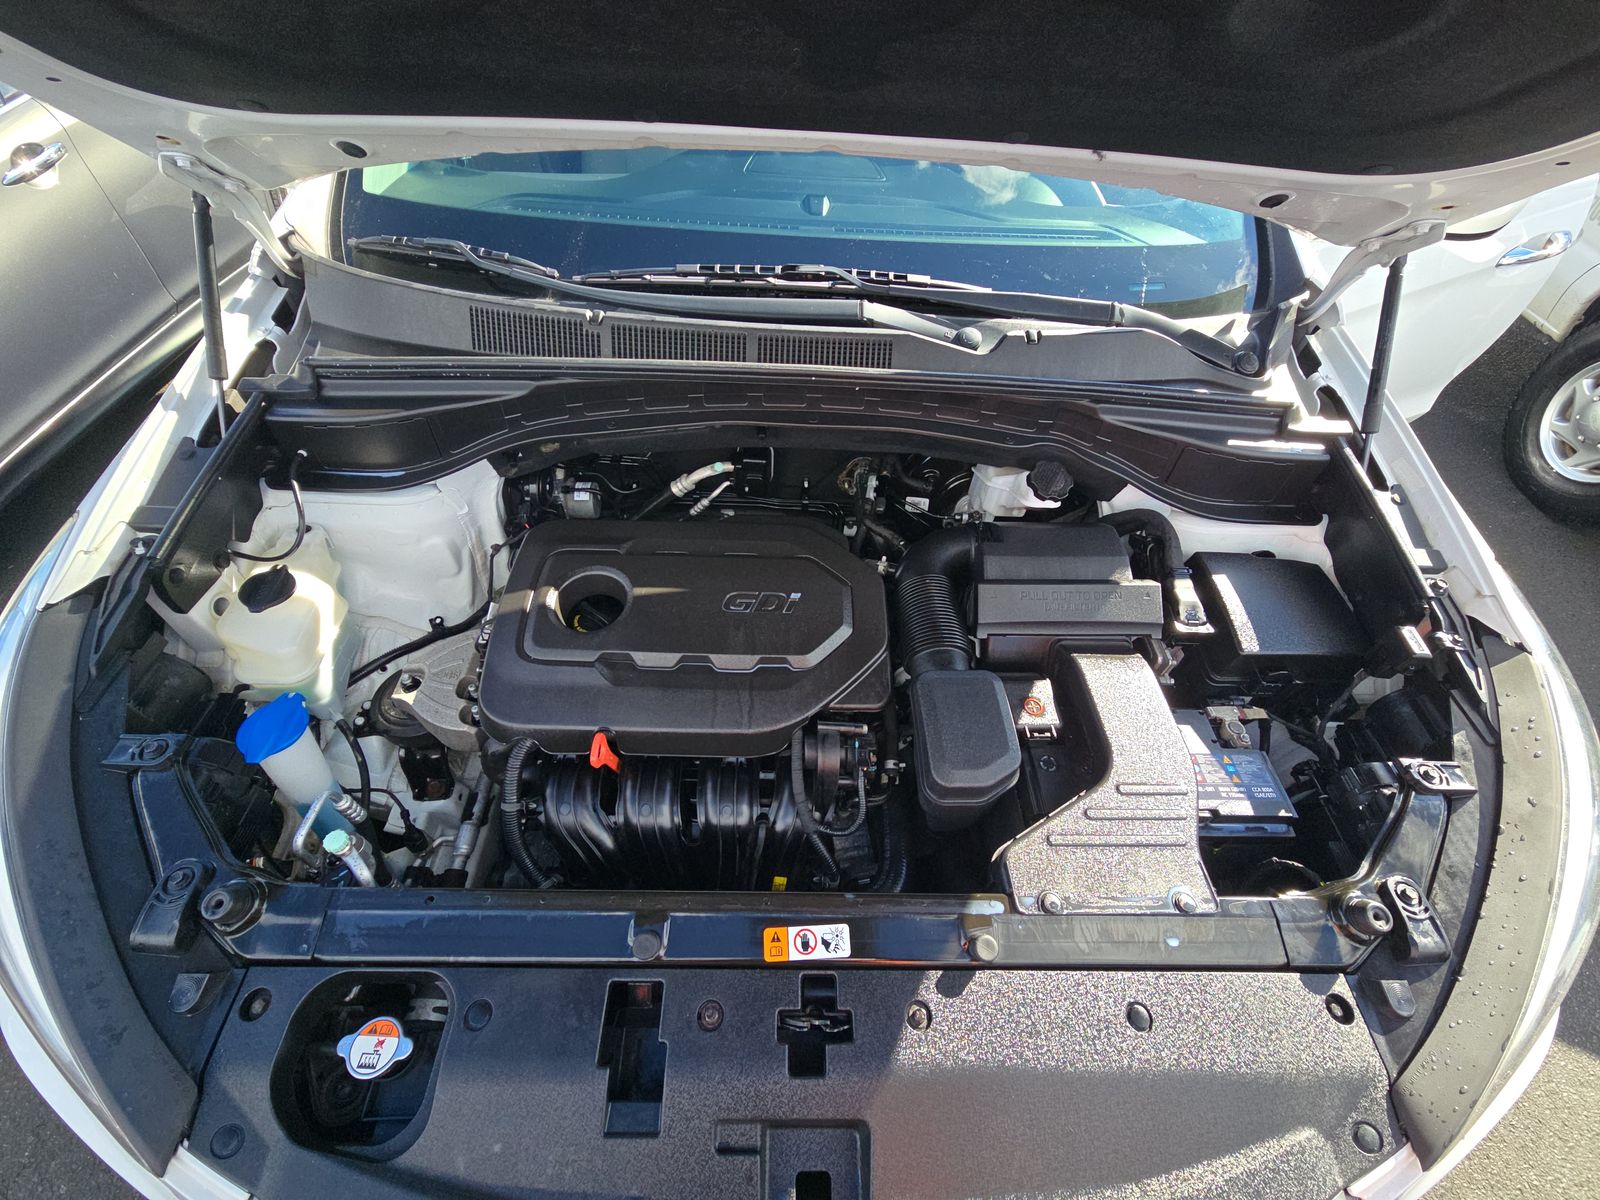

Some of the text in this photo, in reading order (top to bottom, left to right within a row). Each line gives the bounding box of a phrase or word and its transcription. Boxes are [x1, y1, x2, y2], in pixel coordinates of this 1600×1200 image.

[1020, 591, 1122, 600] PULL OUT TO OPEN
